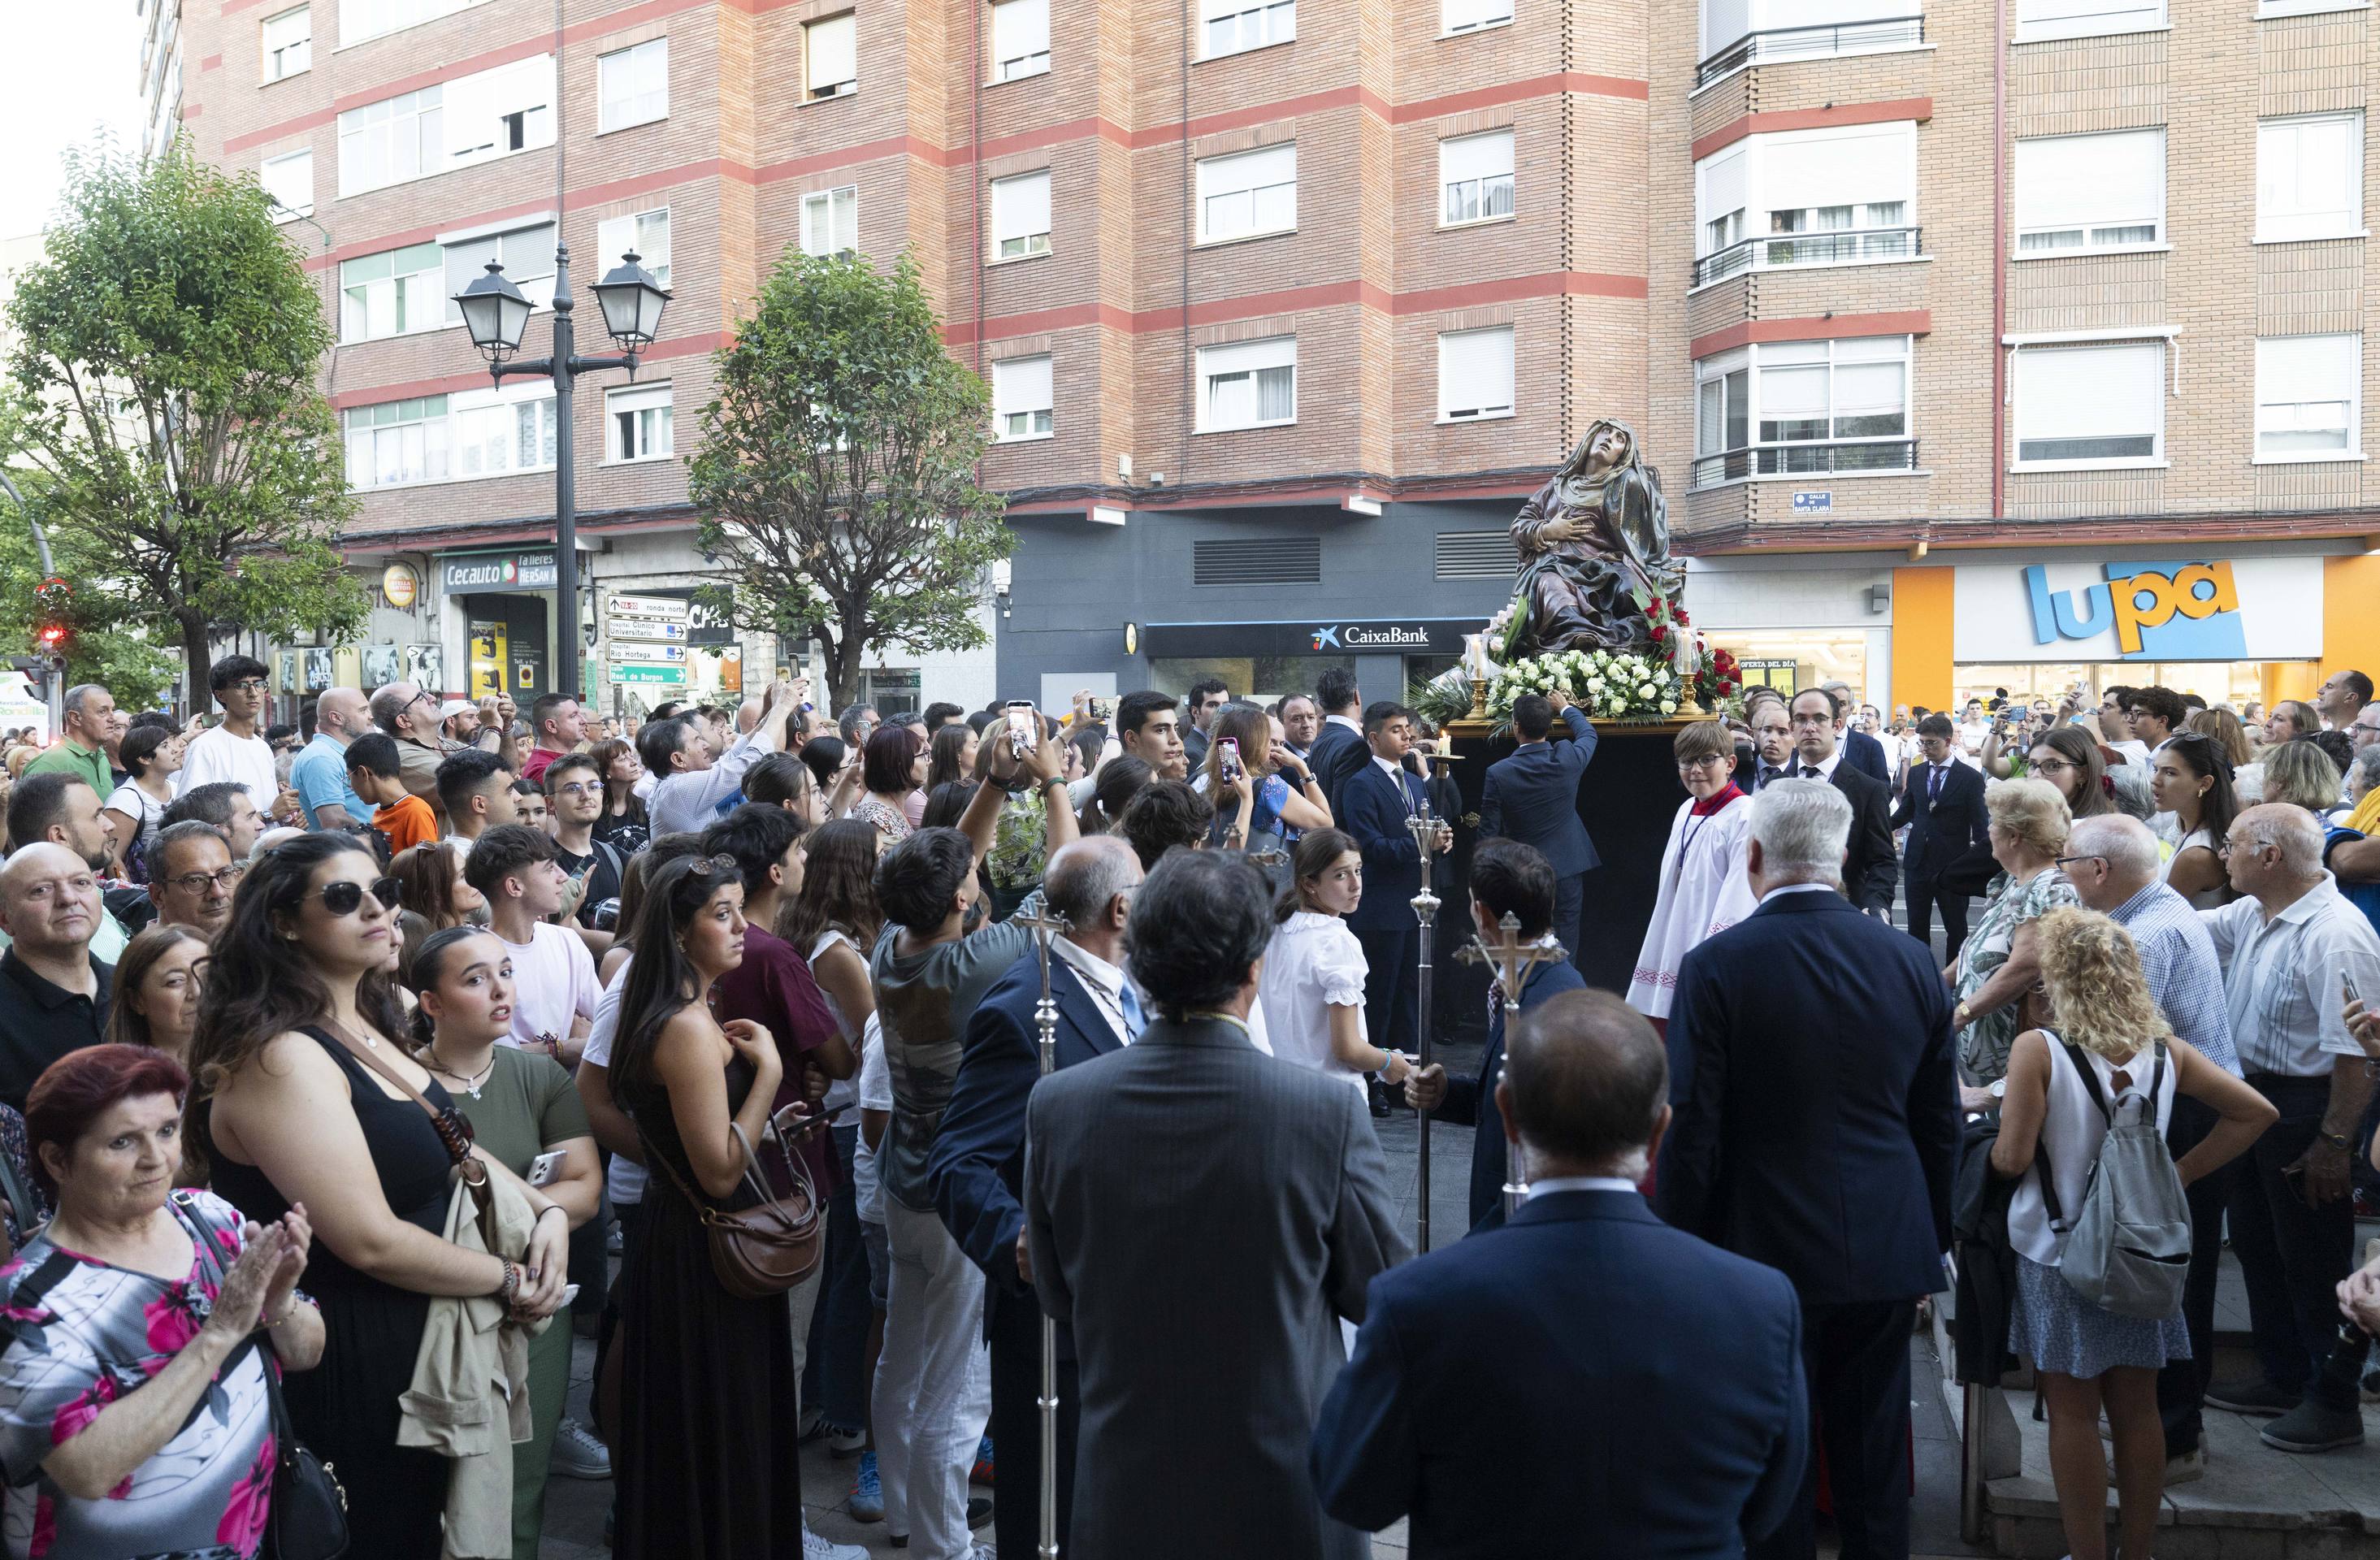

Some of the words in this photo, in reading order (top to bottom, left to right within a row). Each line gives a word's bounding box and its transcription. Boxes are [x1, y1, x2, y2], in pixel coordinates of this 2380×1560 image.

[448, 564, 500, 585] Cecauto
[646, 604, 665, 612] ronda
[669, 604, 685, 613] norte
[2023, 560, 2239, 653] lupa
[610, 627, 652, 637] Universitario
[1345, 626, 1429, 644] CaixaBank
[625, 651, 651, 660] Hortega
[1782, 660, 1796, 668] DÍA
[611, 672, 626, 681] Real
[629, 673, 638, 682] de
[640, 674, 664, 682] Burgos
